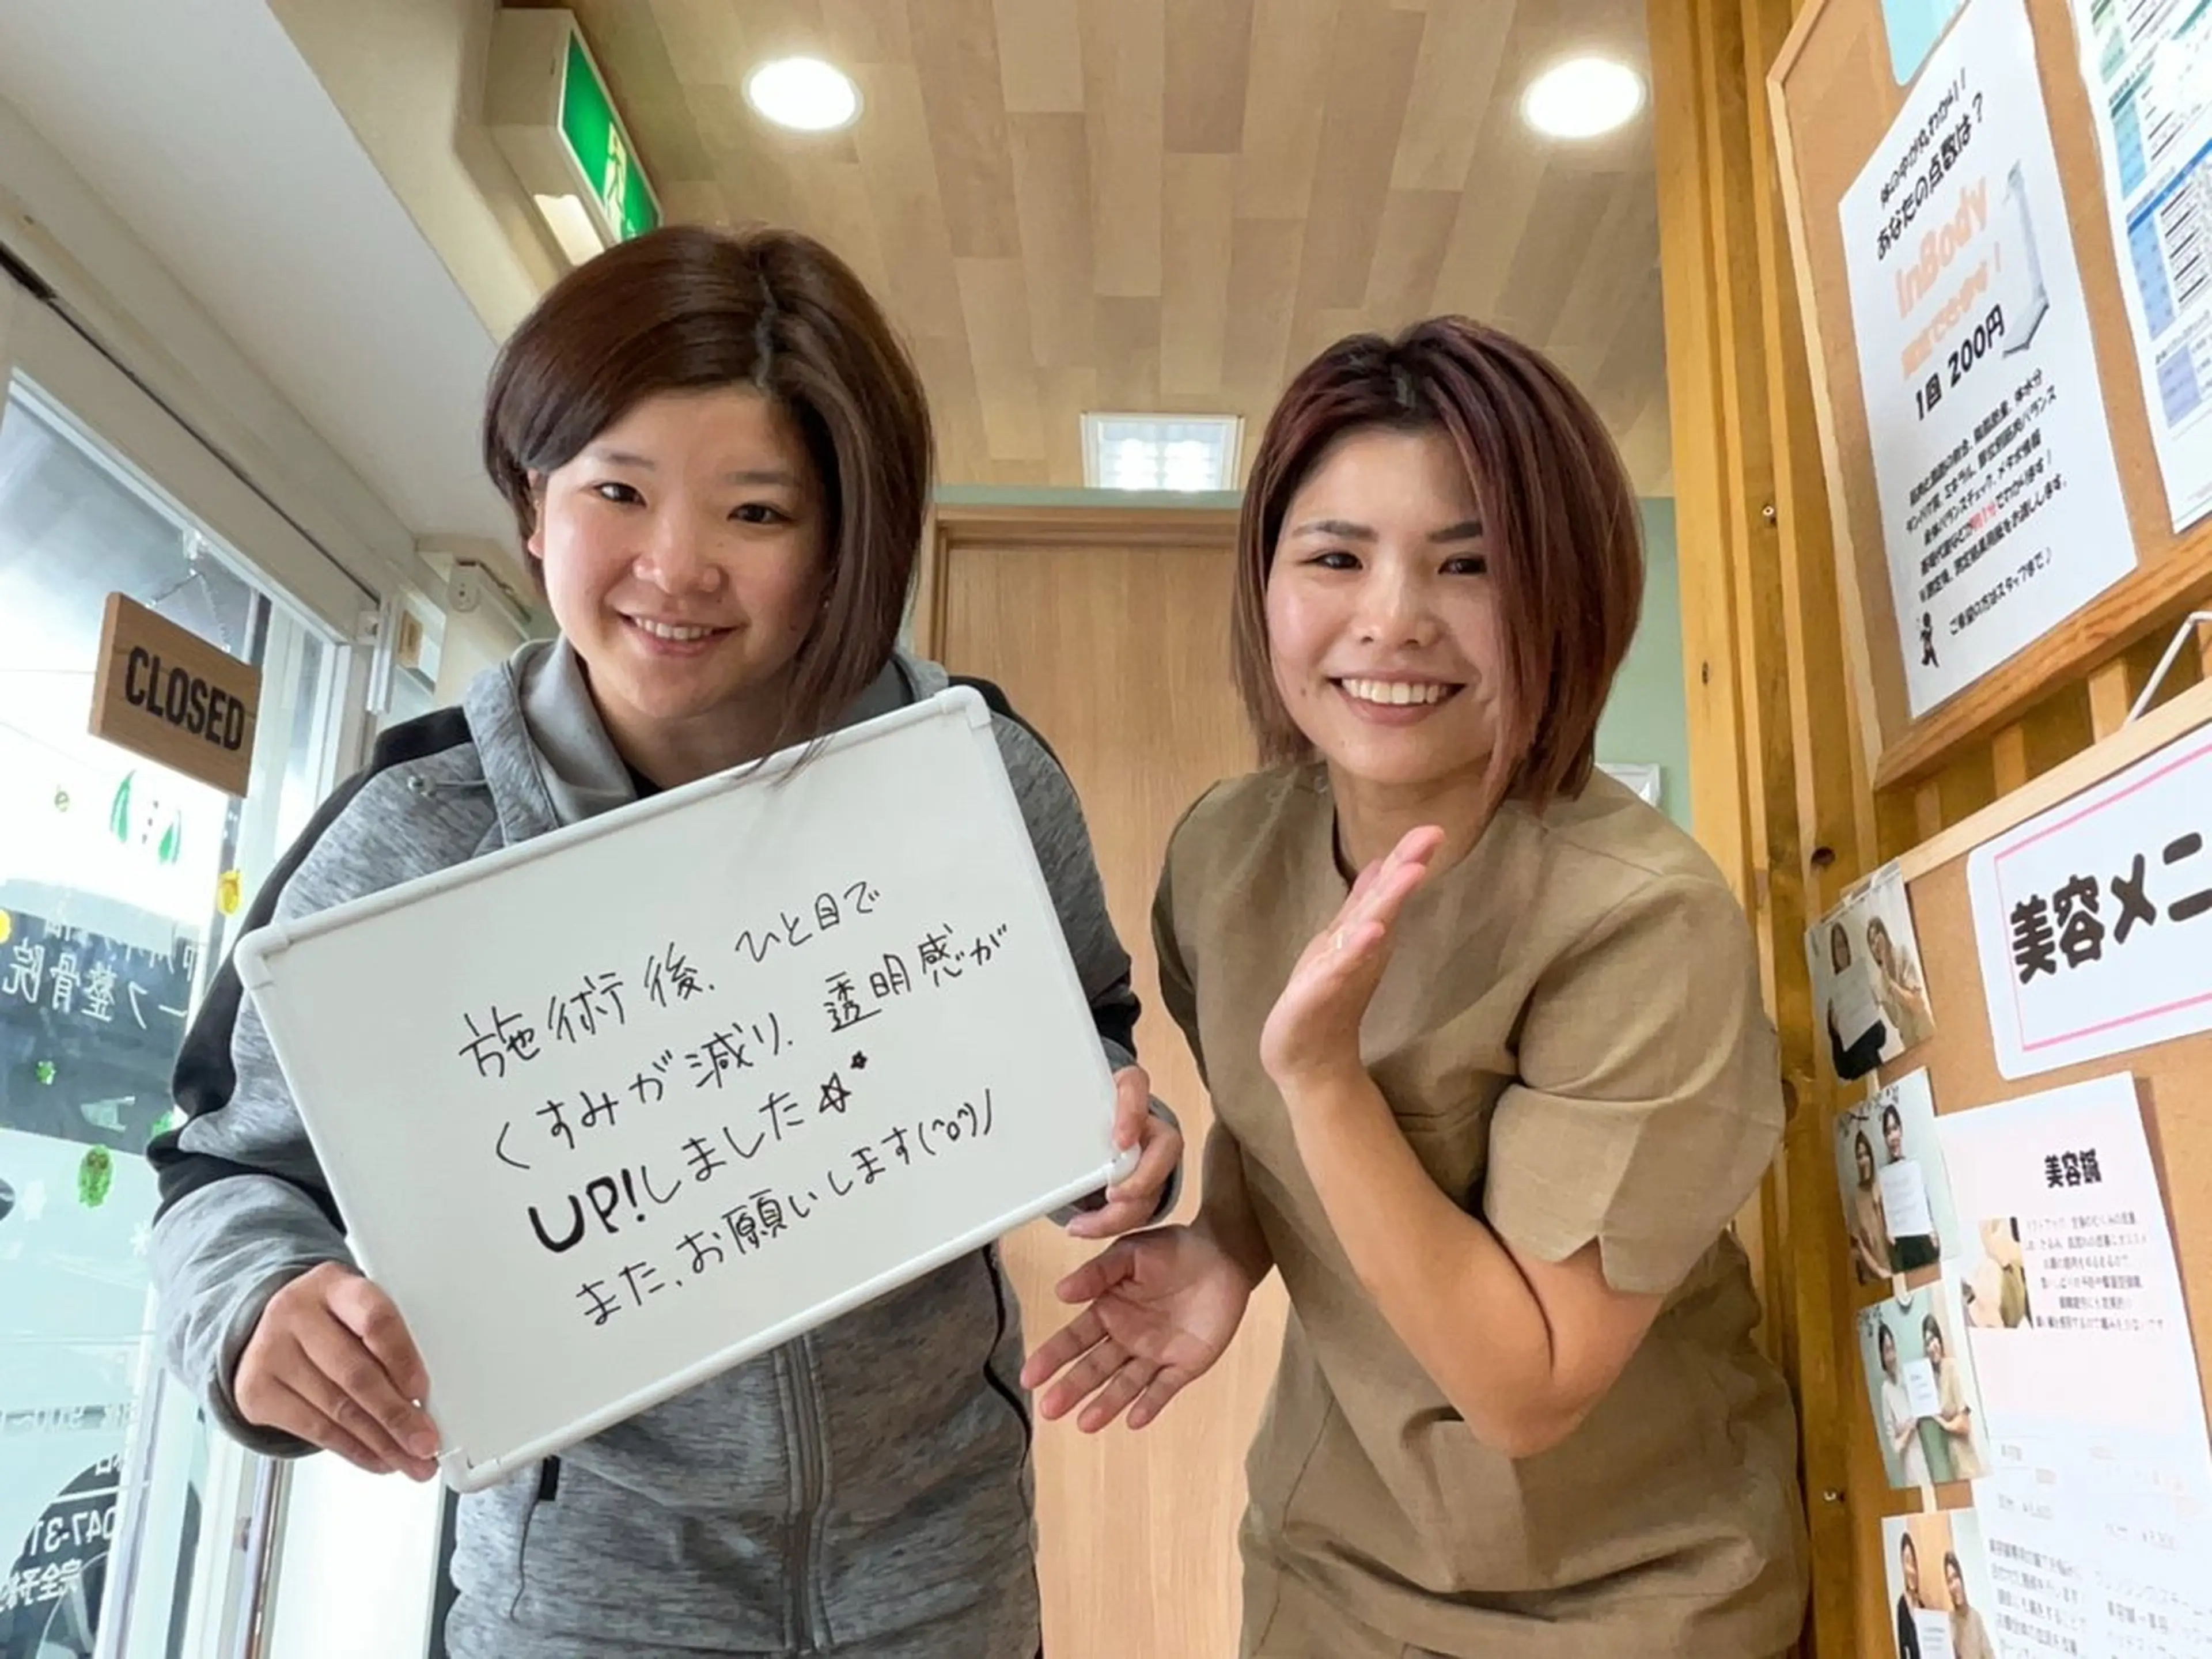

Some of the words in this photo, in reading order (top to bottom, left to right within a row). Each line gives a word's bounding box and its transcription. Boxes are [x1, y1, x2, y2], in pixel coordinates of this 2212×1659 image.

[1877, 92, 1983, 261] あなたの点数は？
[1895, 176, 1988, 320] InBody
[1915, 373, 1941, 420] 1回
[1948, 305, 2005, 388] 200円
[124, 645, 246, 752] CLOSED
